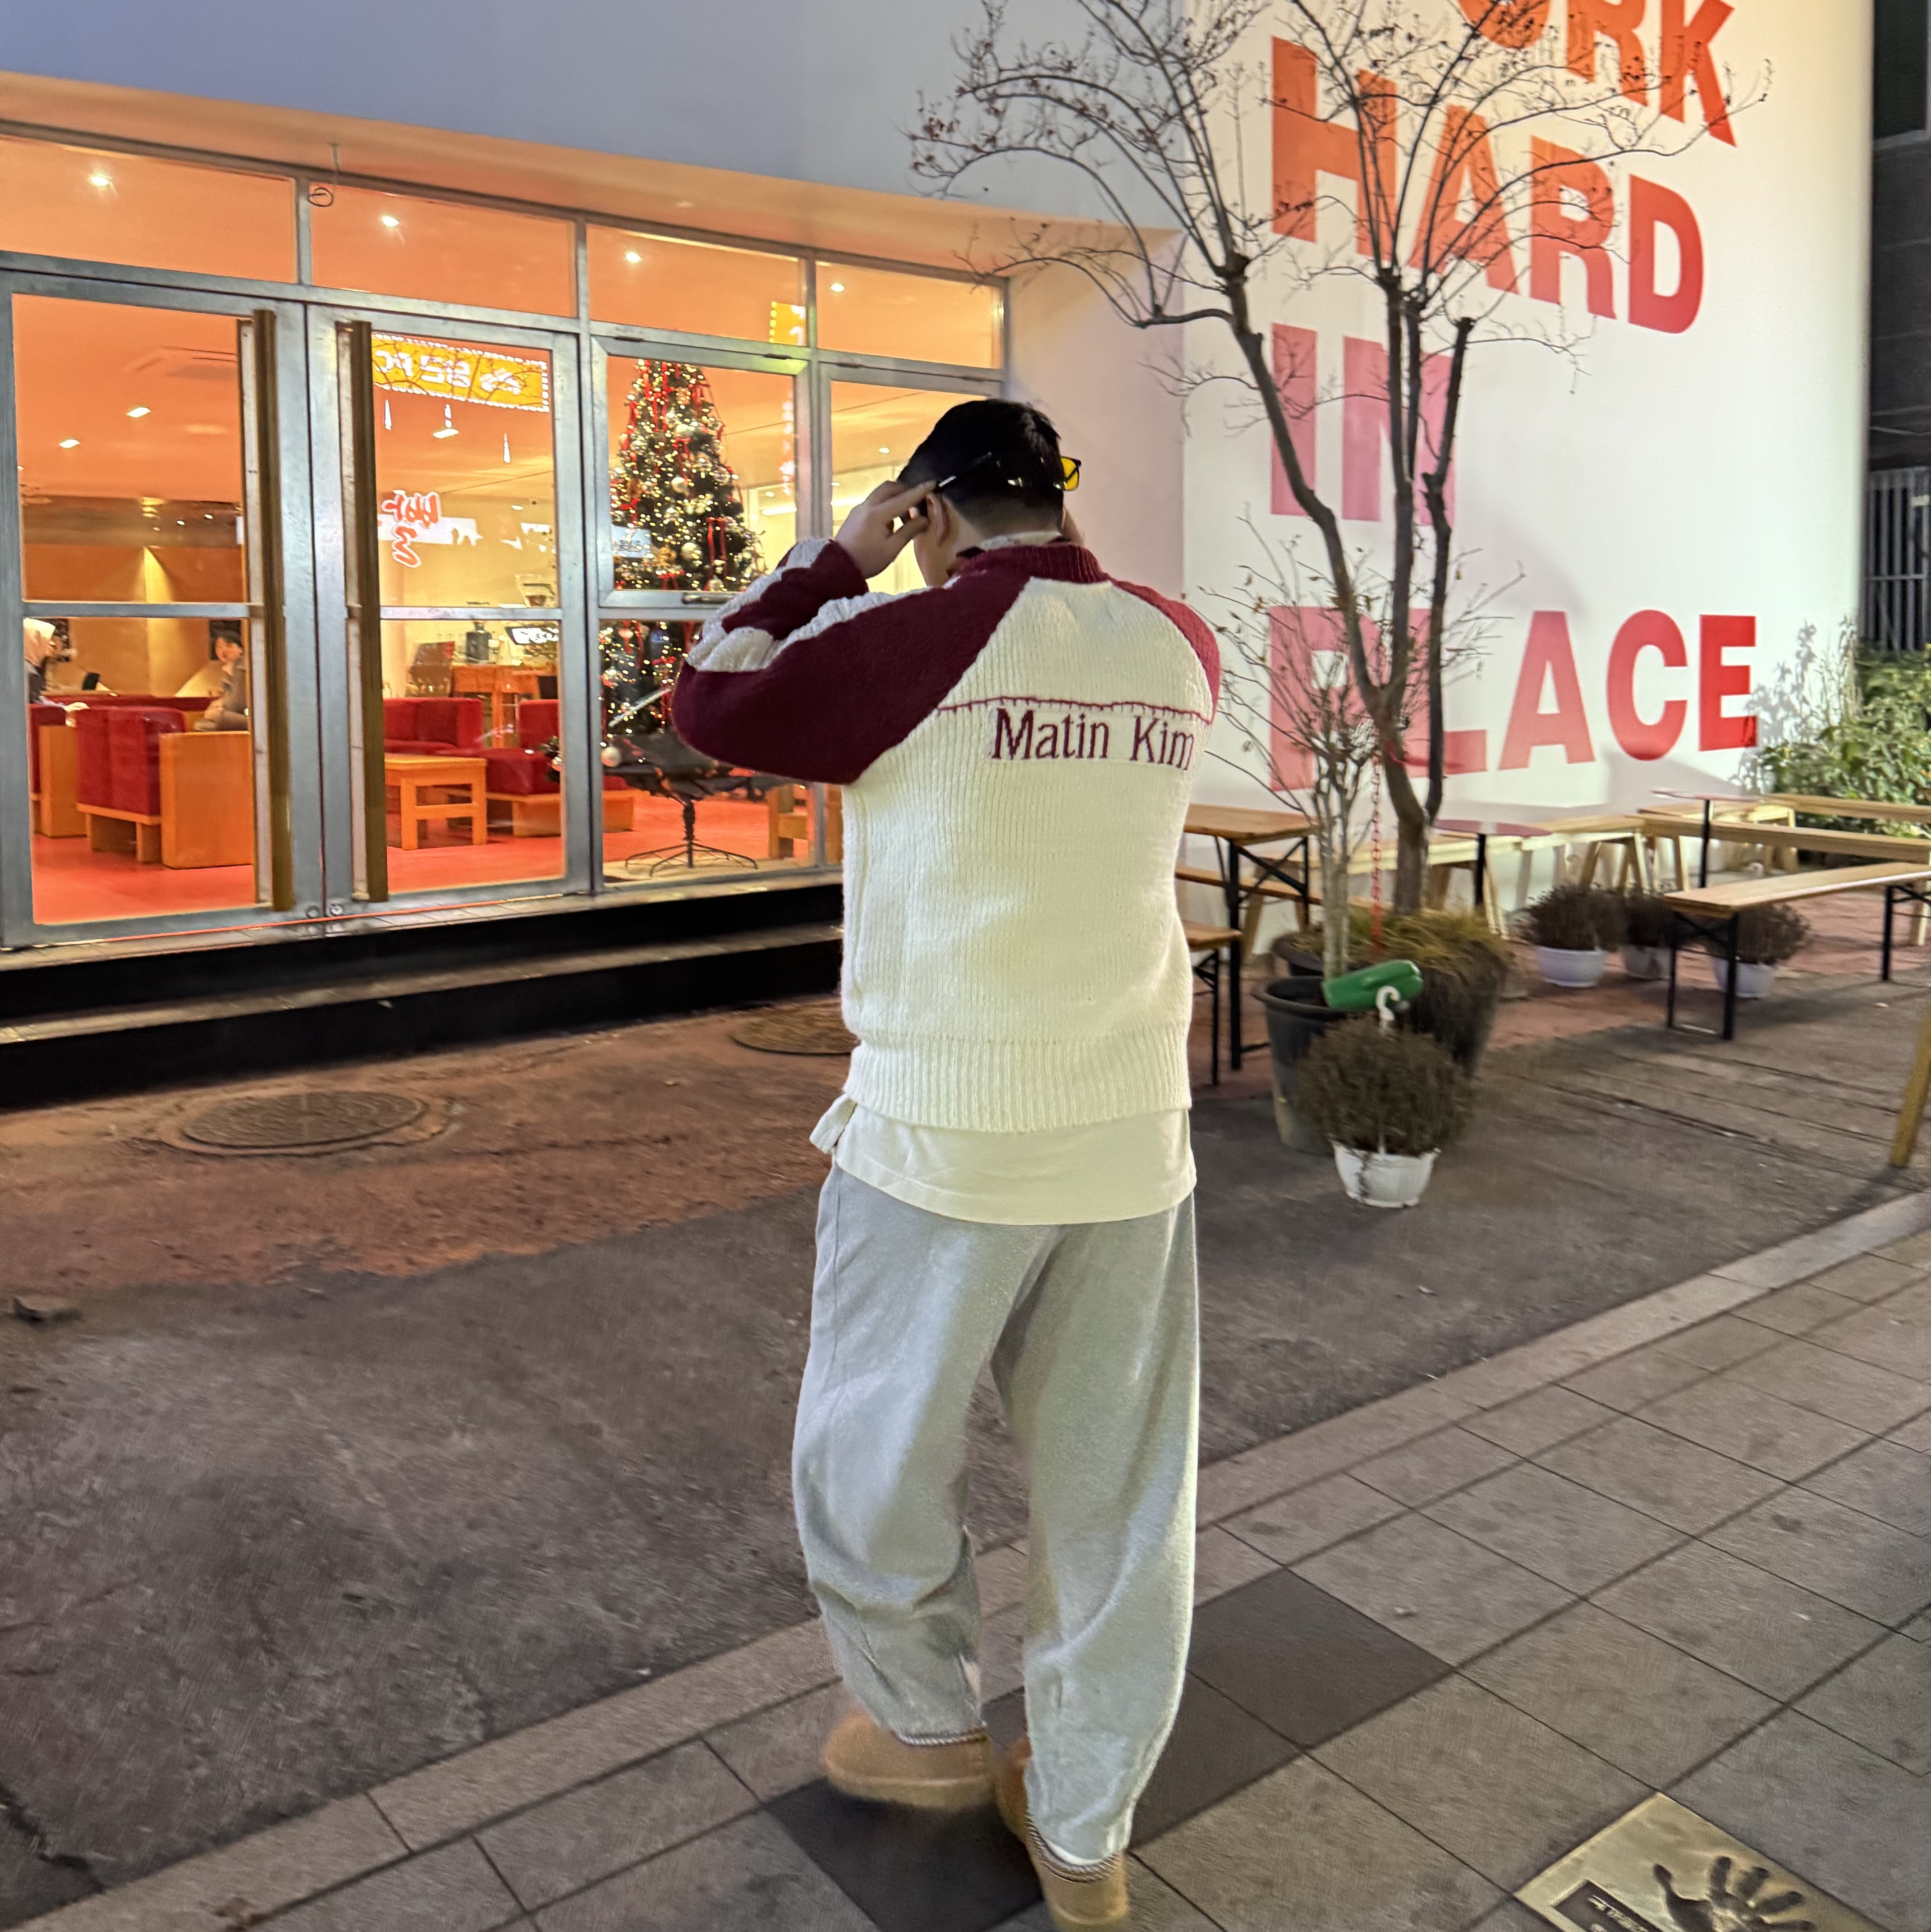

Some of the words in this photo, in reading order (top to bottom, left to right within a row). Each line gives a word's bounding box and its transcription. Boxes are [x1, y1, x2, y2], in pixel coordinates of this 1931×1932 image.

[1272, 36, 1704, 334] HARD
[1270, 322, 1456, 528] IN
[992, 707, 1110, 761] Matin
[1129, 715, 1195, 771] Kim
[1269, 606, 1757, 791] PLACE
